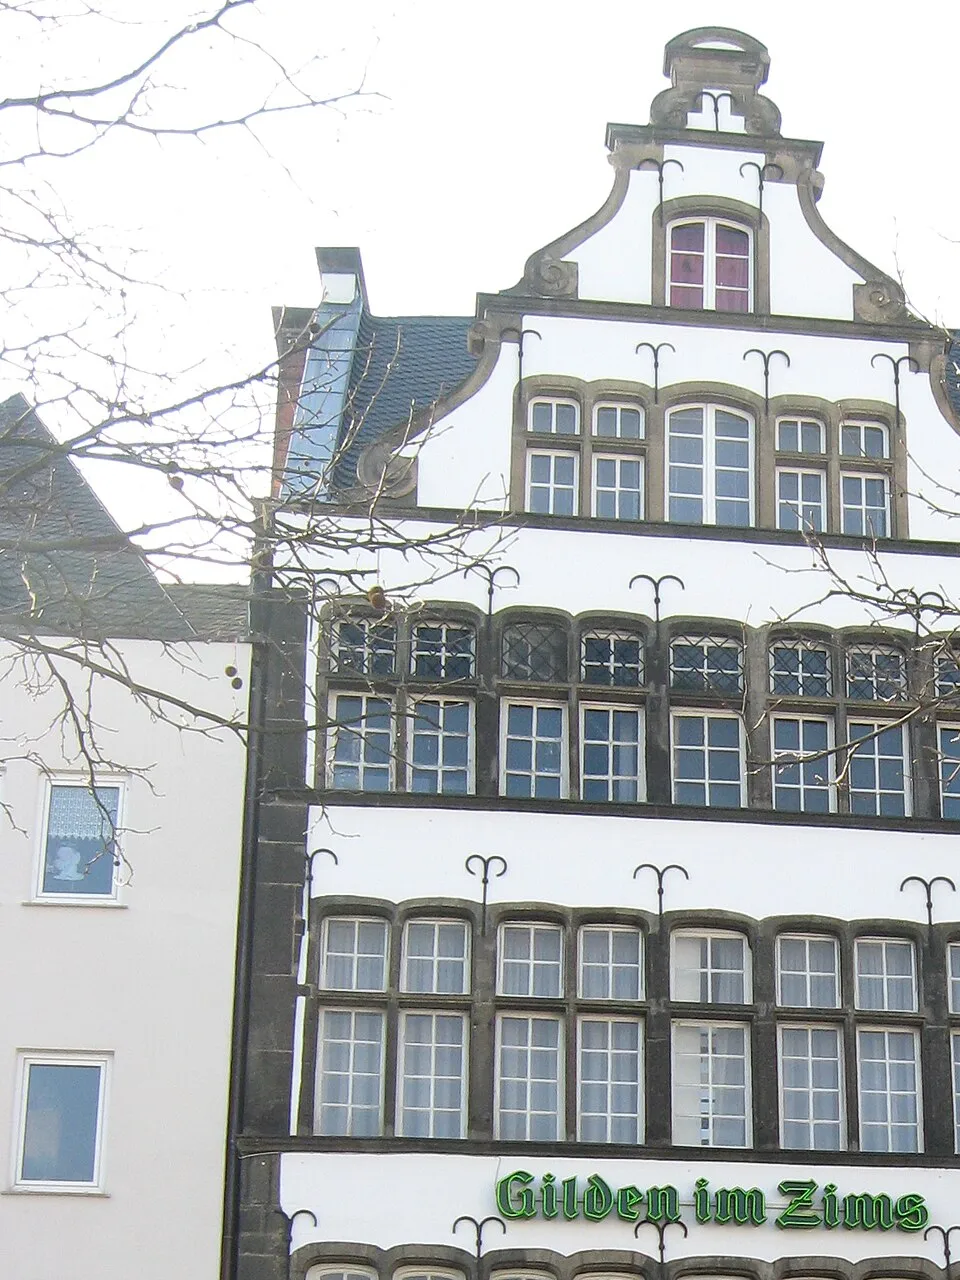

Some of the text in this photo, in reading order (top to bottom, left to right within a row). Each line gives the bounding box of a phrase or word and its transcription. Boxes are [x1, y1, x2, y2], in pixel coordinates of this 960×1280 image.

[496, 1170, 931, 1232] Gilden im Zims
